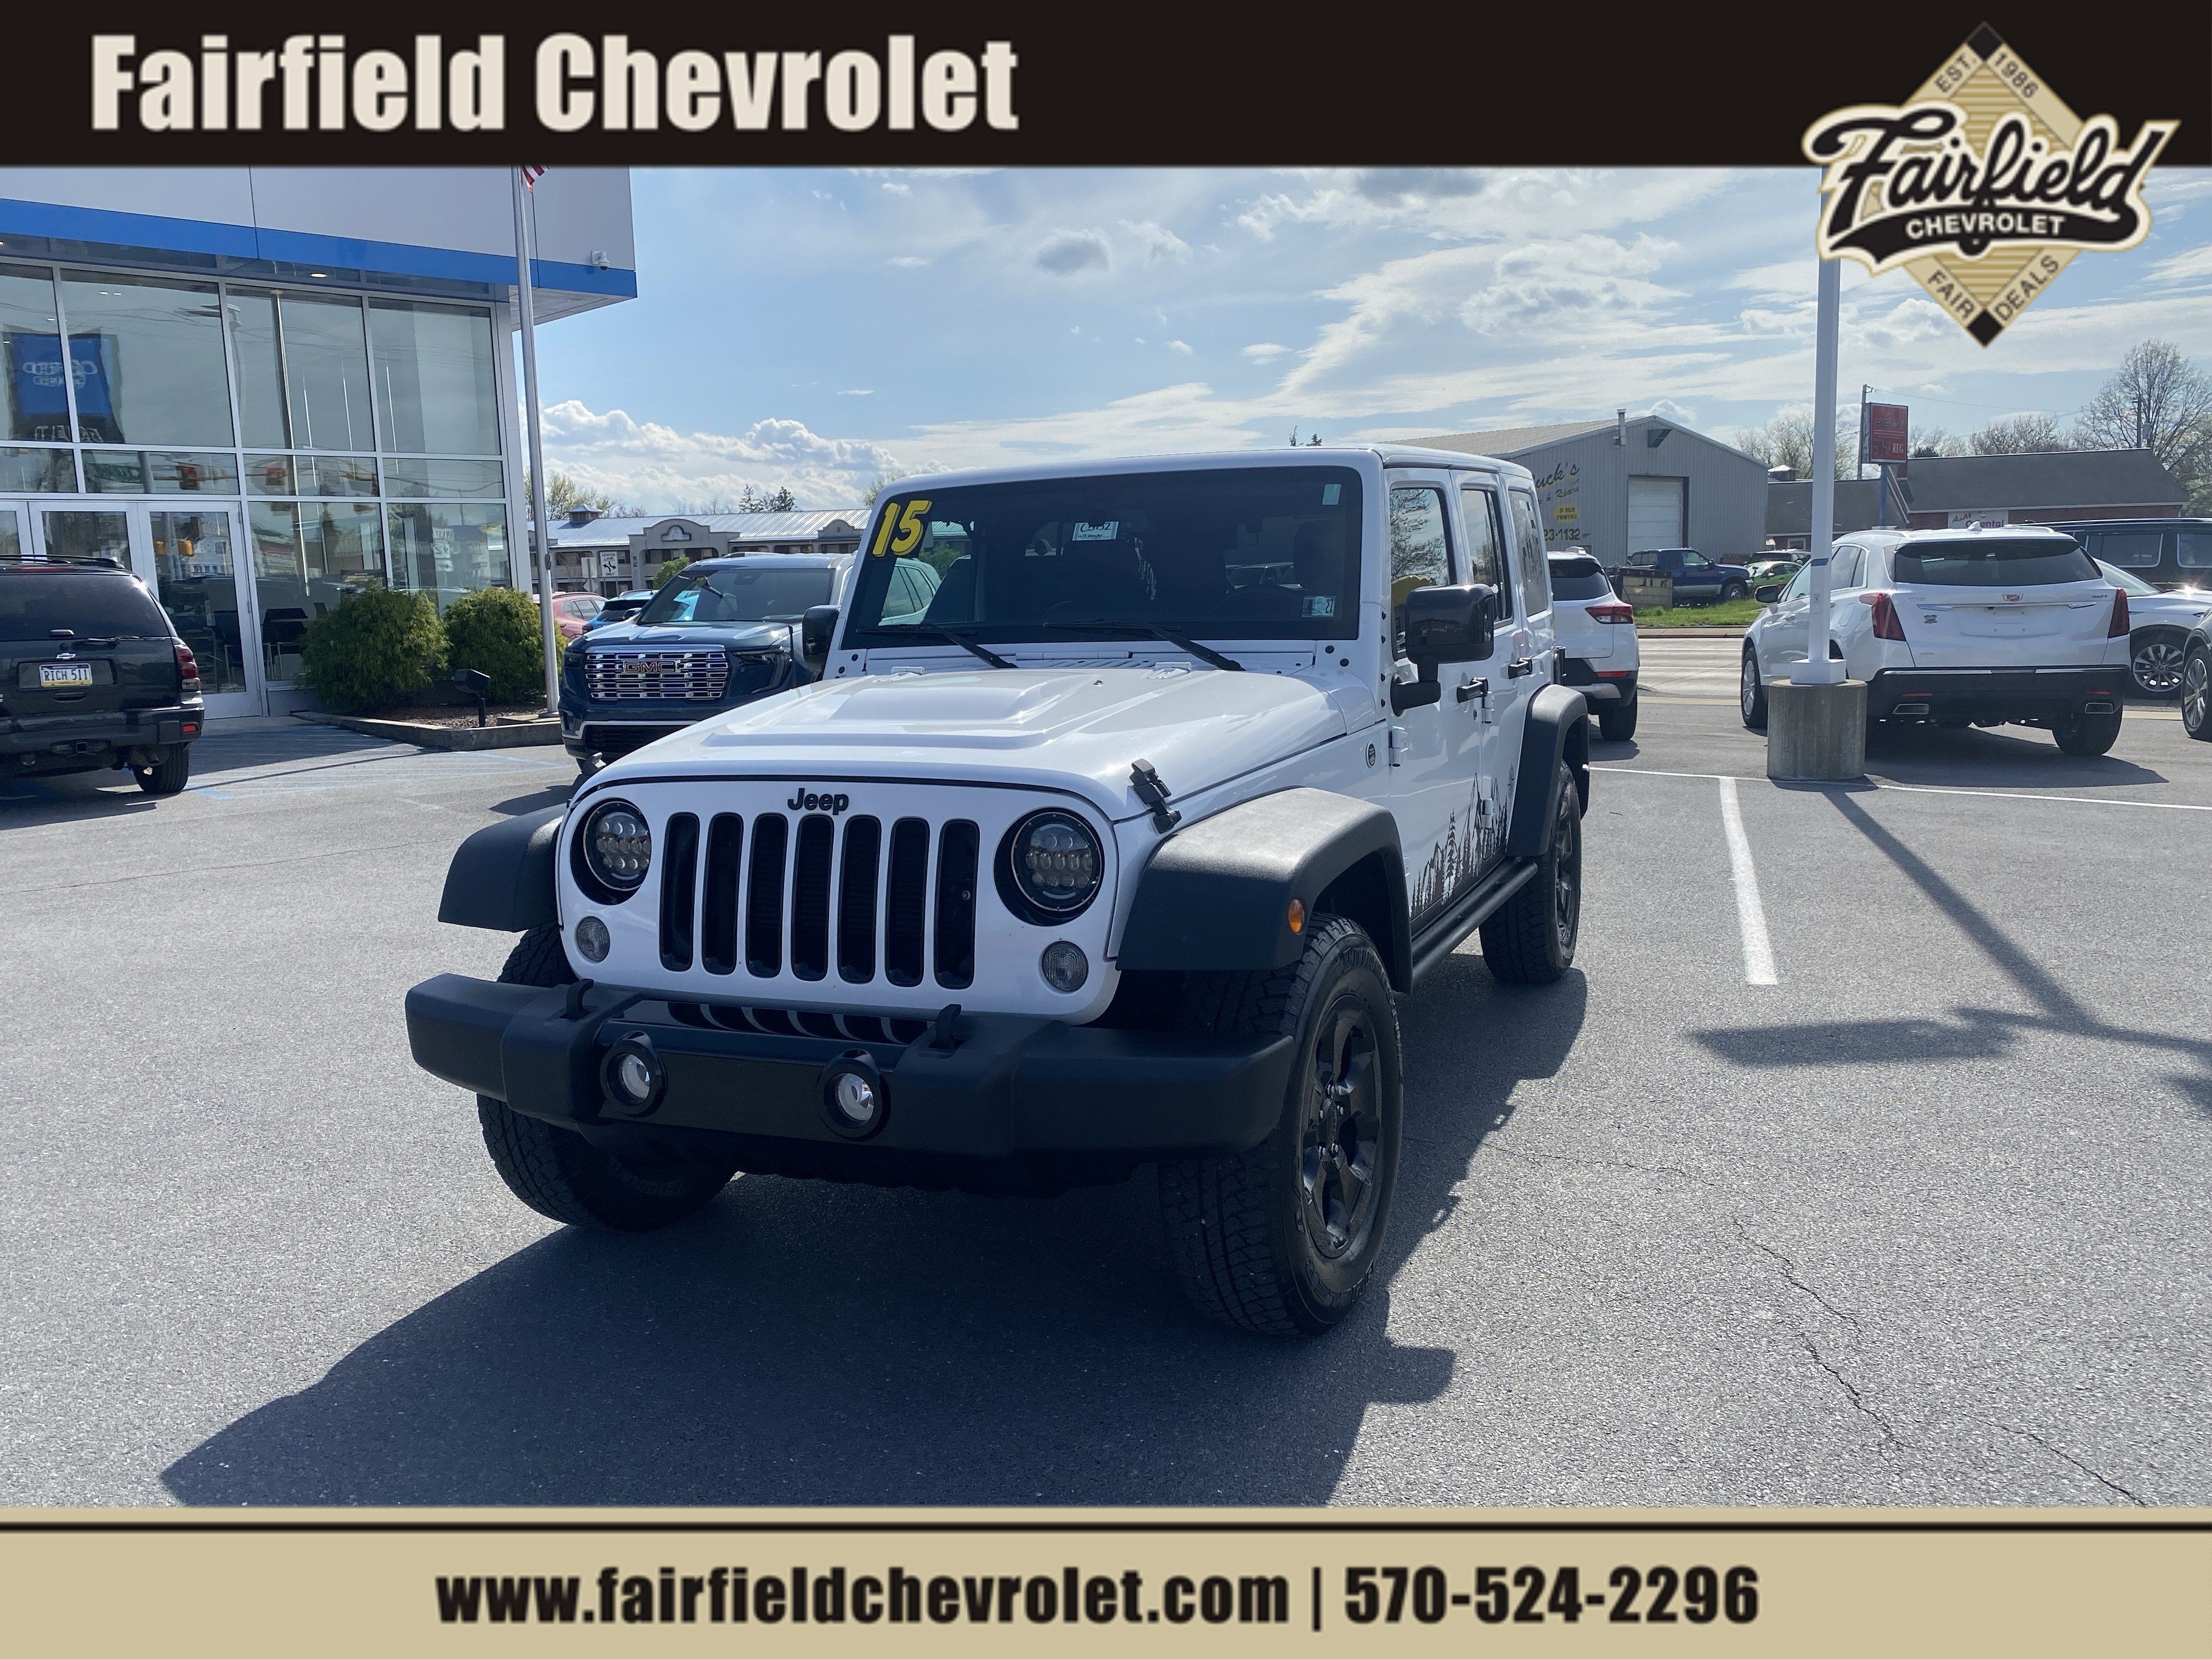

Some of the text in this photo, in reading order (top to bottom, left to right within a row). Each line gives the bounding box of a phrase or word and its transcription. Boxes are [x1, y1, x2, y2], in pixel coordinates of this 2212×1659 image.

[1892, 443, 1904, 454] REG
[1533, 462, 1580, 488] uck's
[1952, 512, 1972, 523] A&M
[872, 500, 933, 557] 15
[1966, 520, 2004, 528] Oental
[625, 662, 674, 673] GMC
[44, 669, 88, 681] RICH 511
[787, 787, 849, 816] Jeep
